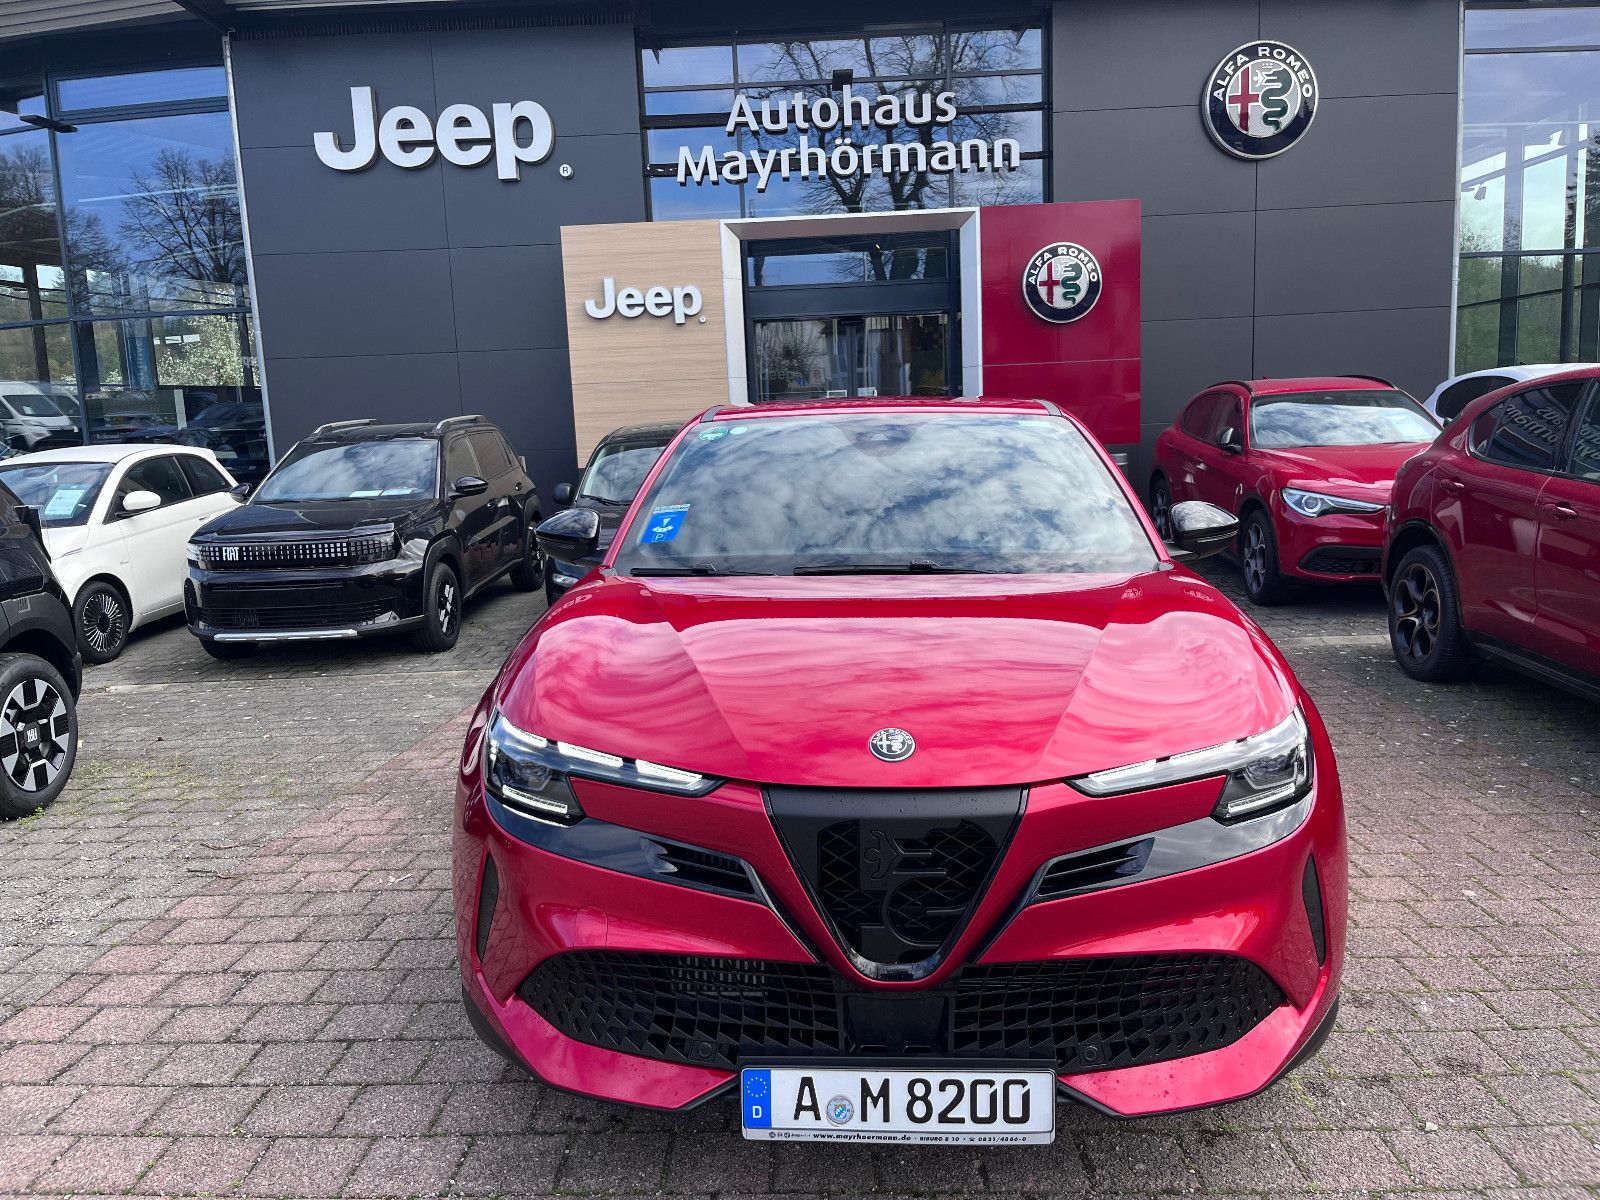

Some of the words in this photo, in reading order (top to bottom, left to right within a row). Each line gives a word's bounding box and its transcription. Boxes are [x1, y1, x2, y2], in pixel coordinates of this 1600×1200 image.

[1214, 53, 1249, 101] ALFA
[1258, 46, 1313, 98] ROMEO
[313, 86, 555, 182] Jeep
[725, 84, 957, 135] Autohaus
[676, 135, 1021, 192] Mayrhörmann
[1028, 252, 1053, 285] ALFA
[1057, 246, 1098, 282] ROMEO
[584, 277, 703, 325] Jeep
[222, 546, 240, 561] FIAT
[752, 1106, 762, 1119] D
[793, 1076, 822, 1121] A
[860, 1077, 890, 1123] M
[906, 1077, 1031, 1125] 8200
